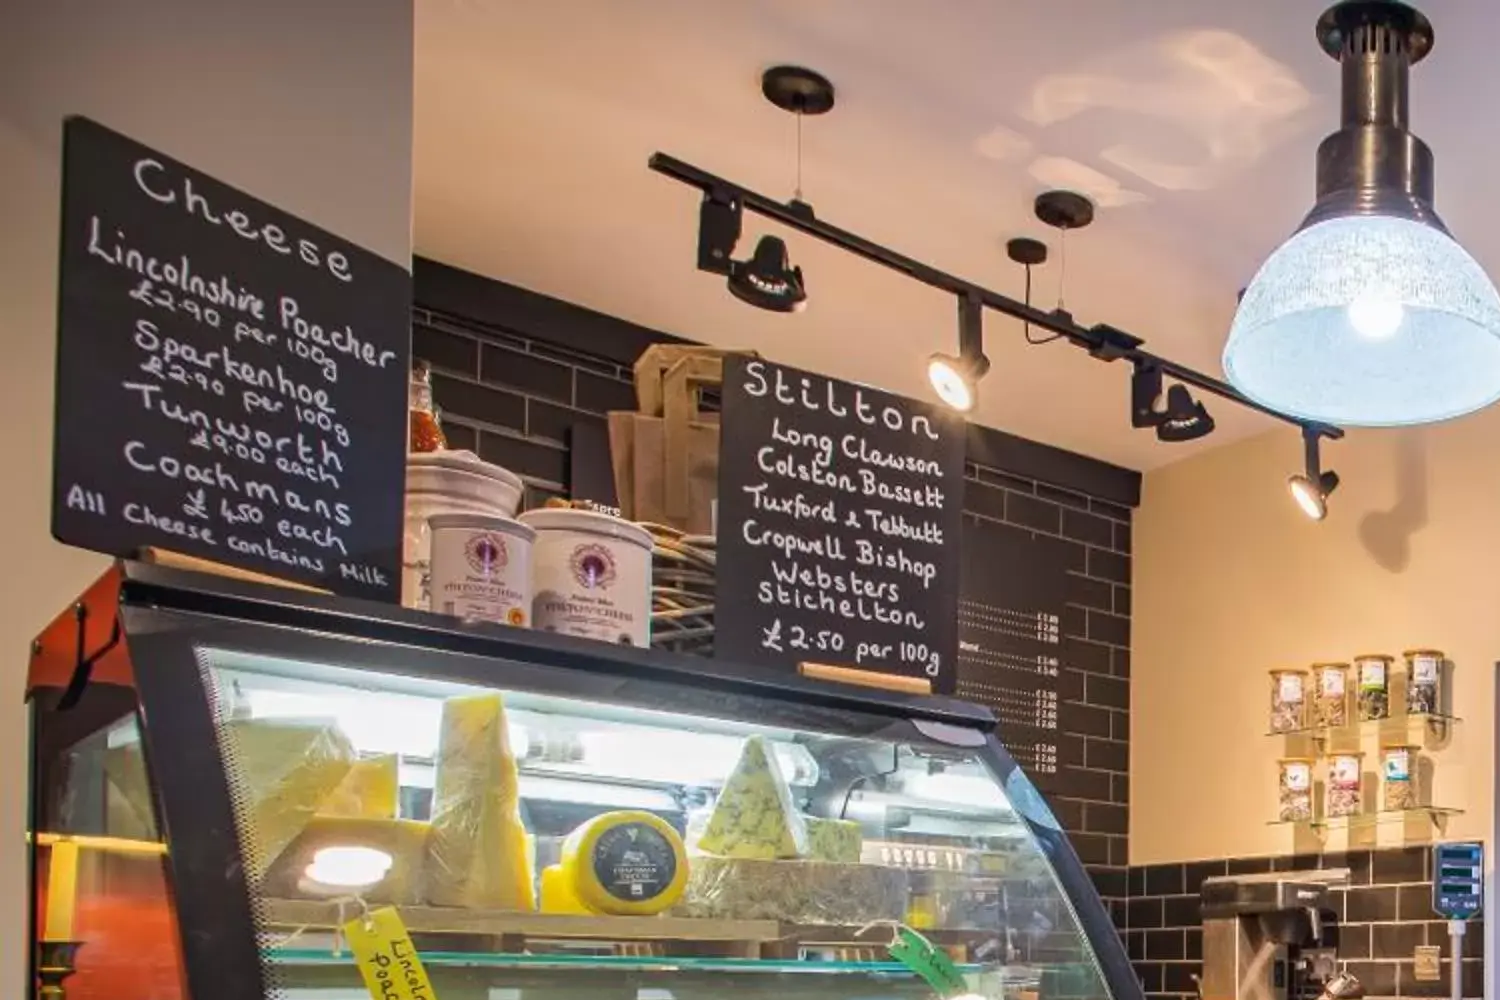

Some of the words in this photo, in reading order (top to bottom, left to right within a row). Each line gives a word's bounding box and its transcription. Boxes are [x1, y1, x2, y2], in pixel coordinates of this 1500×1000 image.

[133, 158, 353, 281] Cheese
[88, 216, 264, 319] Lincolnshire
[280, 296, 397, 369] Poacher
[134, 321, 336, 414] Sparkenhoe
[234, 321, 277, 346] per
[287, 337, 338, 382] 100g
[122, 382, 343, 472] Tunworth
[242, 385, 283, 412] per
[296, 405, 350, 447] 100g
[743, 361, 939, 441] Stilton
[277, 454, 339, 489] each
[757, 447, 856, 494] Colston
[862, 478, 945, 510] Bassett
[772, 417, 833, 466] Long
[841, 434, 944, 478] Clawson
[124, 441, 352, 526] Coachmans
[743, 482, 836, 525] Tuxford
[865, 508, 945, 545] Tebbutt
[66, 484, 105, 515] All
[123, 503, 218, 545] Cheese
[228, 534, 323, 573] contains
[340, 561, 389, 588] Milk
[277, 519, 347, 555] each
[743, 519, 846, 563] Cropwell
[856, 538, 937, 589] Bishop
[758, 581, 925, 630] Stichelton
[771, 561, 900, 602] Websters
[856, 640, 893, 665] per
[899, 639, 941, 677] 100g
